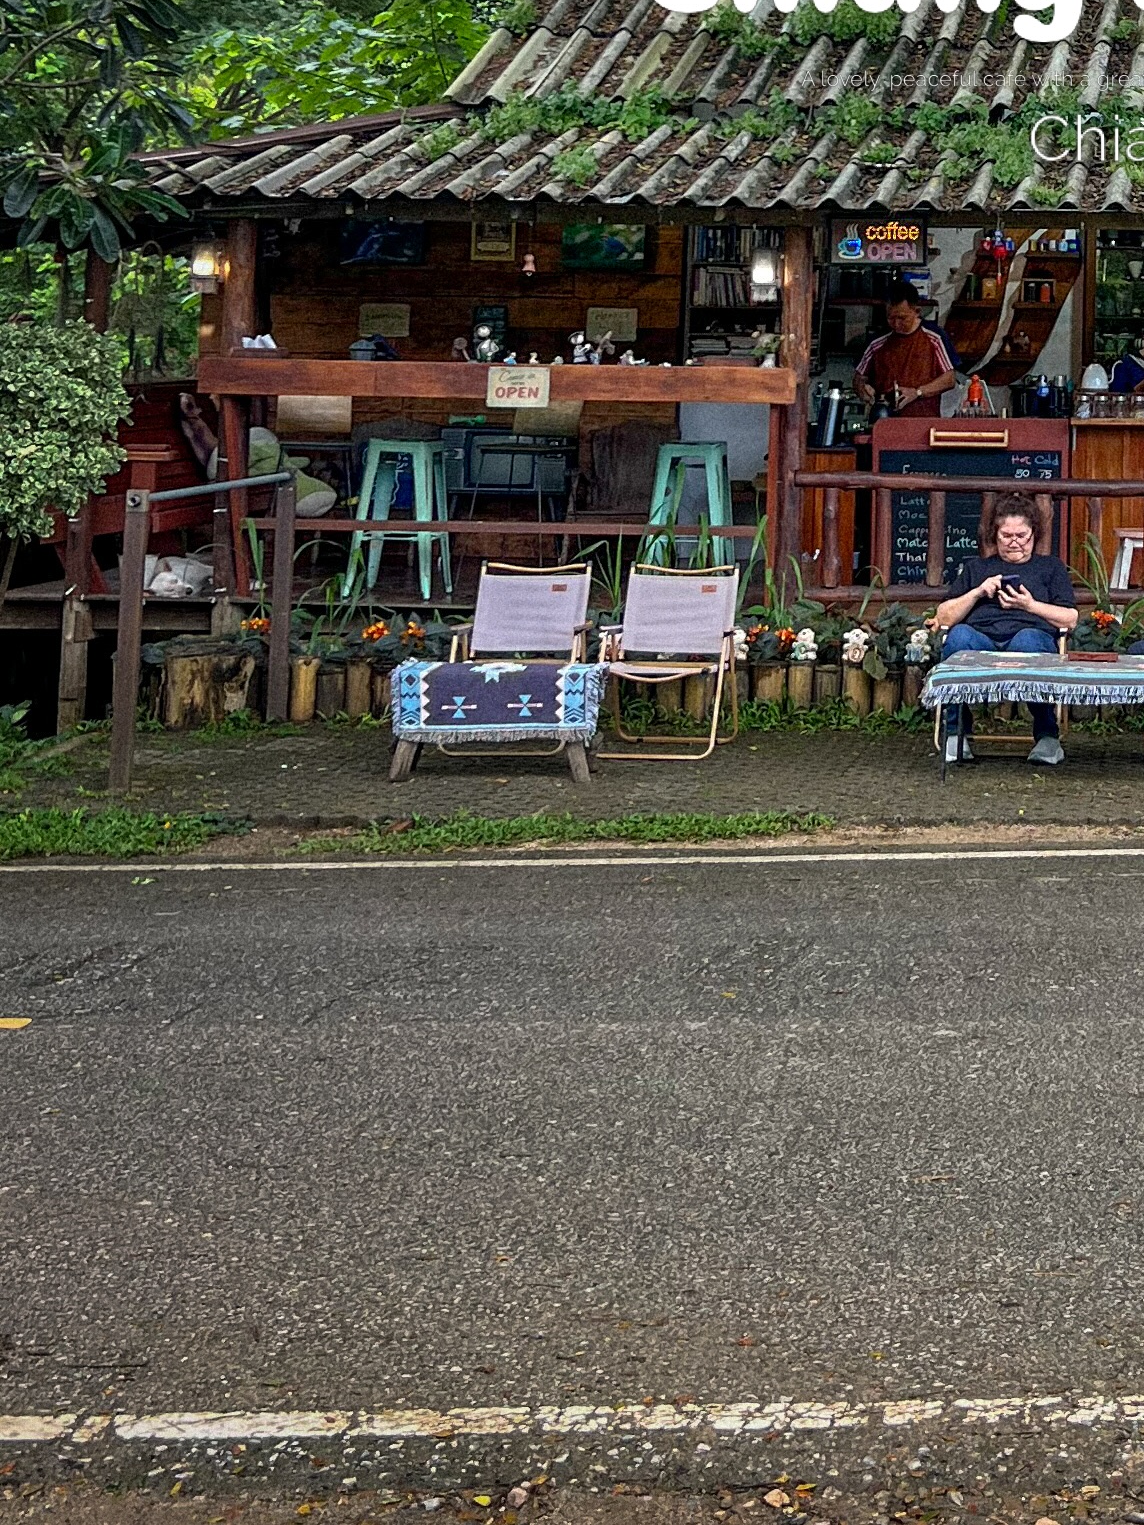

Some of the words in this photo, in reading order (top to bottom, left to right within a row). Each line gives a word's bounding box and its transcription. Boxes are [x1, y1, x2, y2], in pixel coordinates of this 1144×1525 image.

[865, 221, 919, 241] coffee
[867, 242, 917, 261] OPEN
[494, 386, 540, 399] OPEN
[1011, 454, 1032, 465] Hot
[1034, 453, 1059, 466] Cold
[946, 536, 979, 549] Latte
